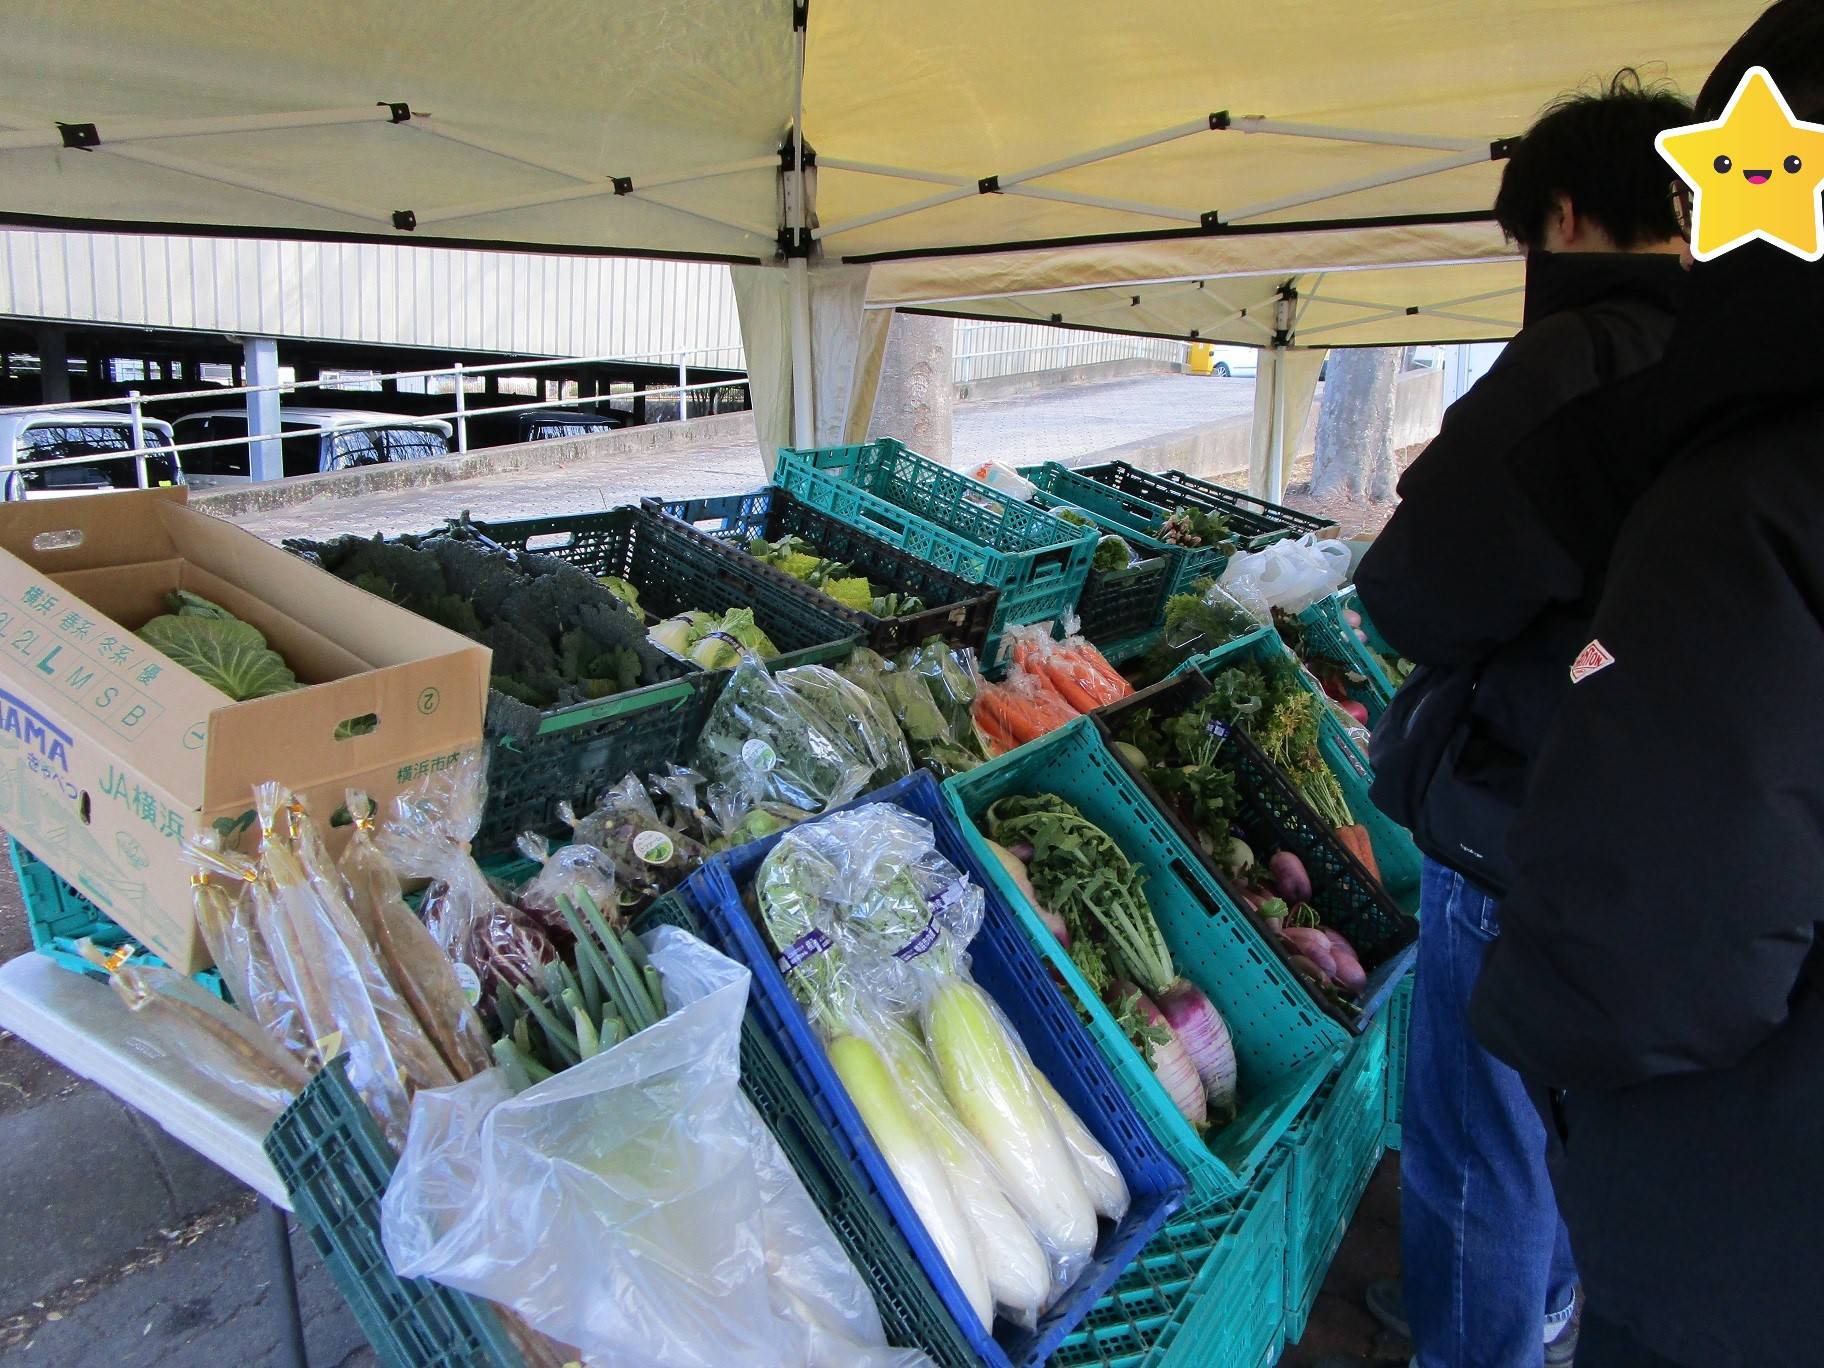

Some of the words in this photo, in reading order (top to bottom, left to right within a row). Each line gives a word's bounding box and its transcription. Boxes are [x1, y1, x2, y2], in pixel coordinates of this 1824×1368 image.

[11, 629, 40, 656] 2L
[36, 644, 63, 675] L
[65, 665, 95, 690] M
[95, 686, 120, 708] S
[121, 704, 147, 727] B
[98, 763, 185, 839] JA横浜
